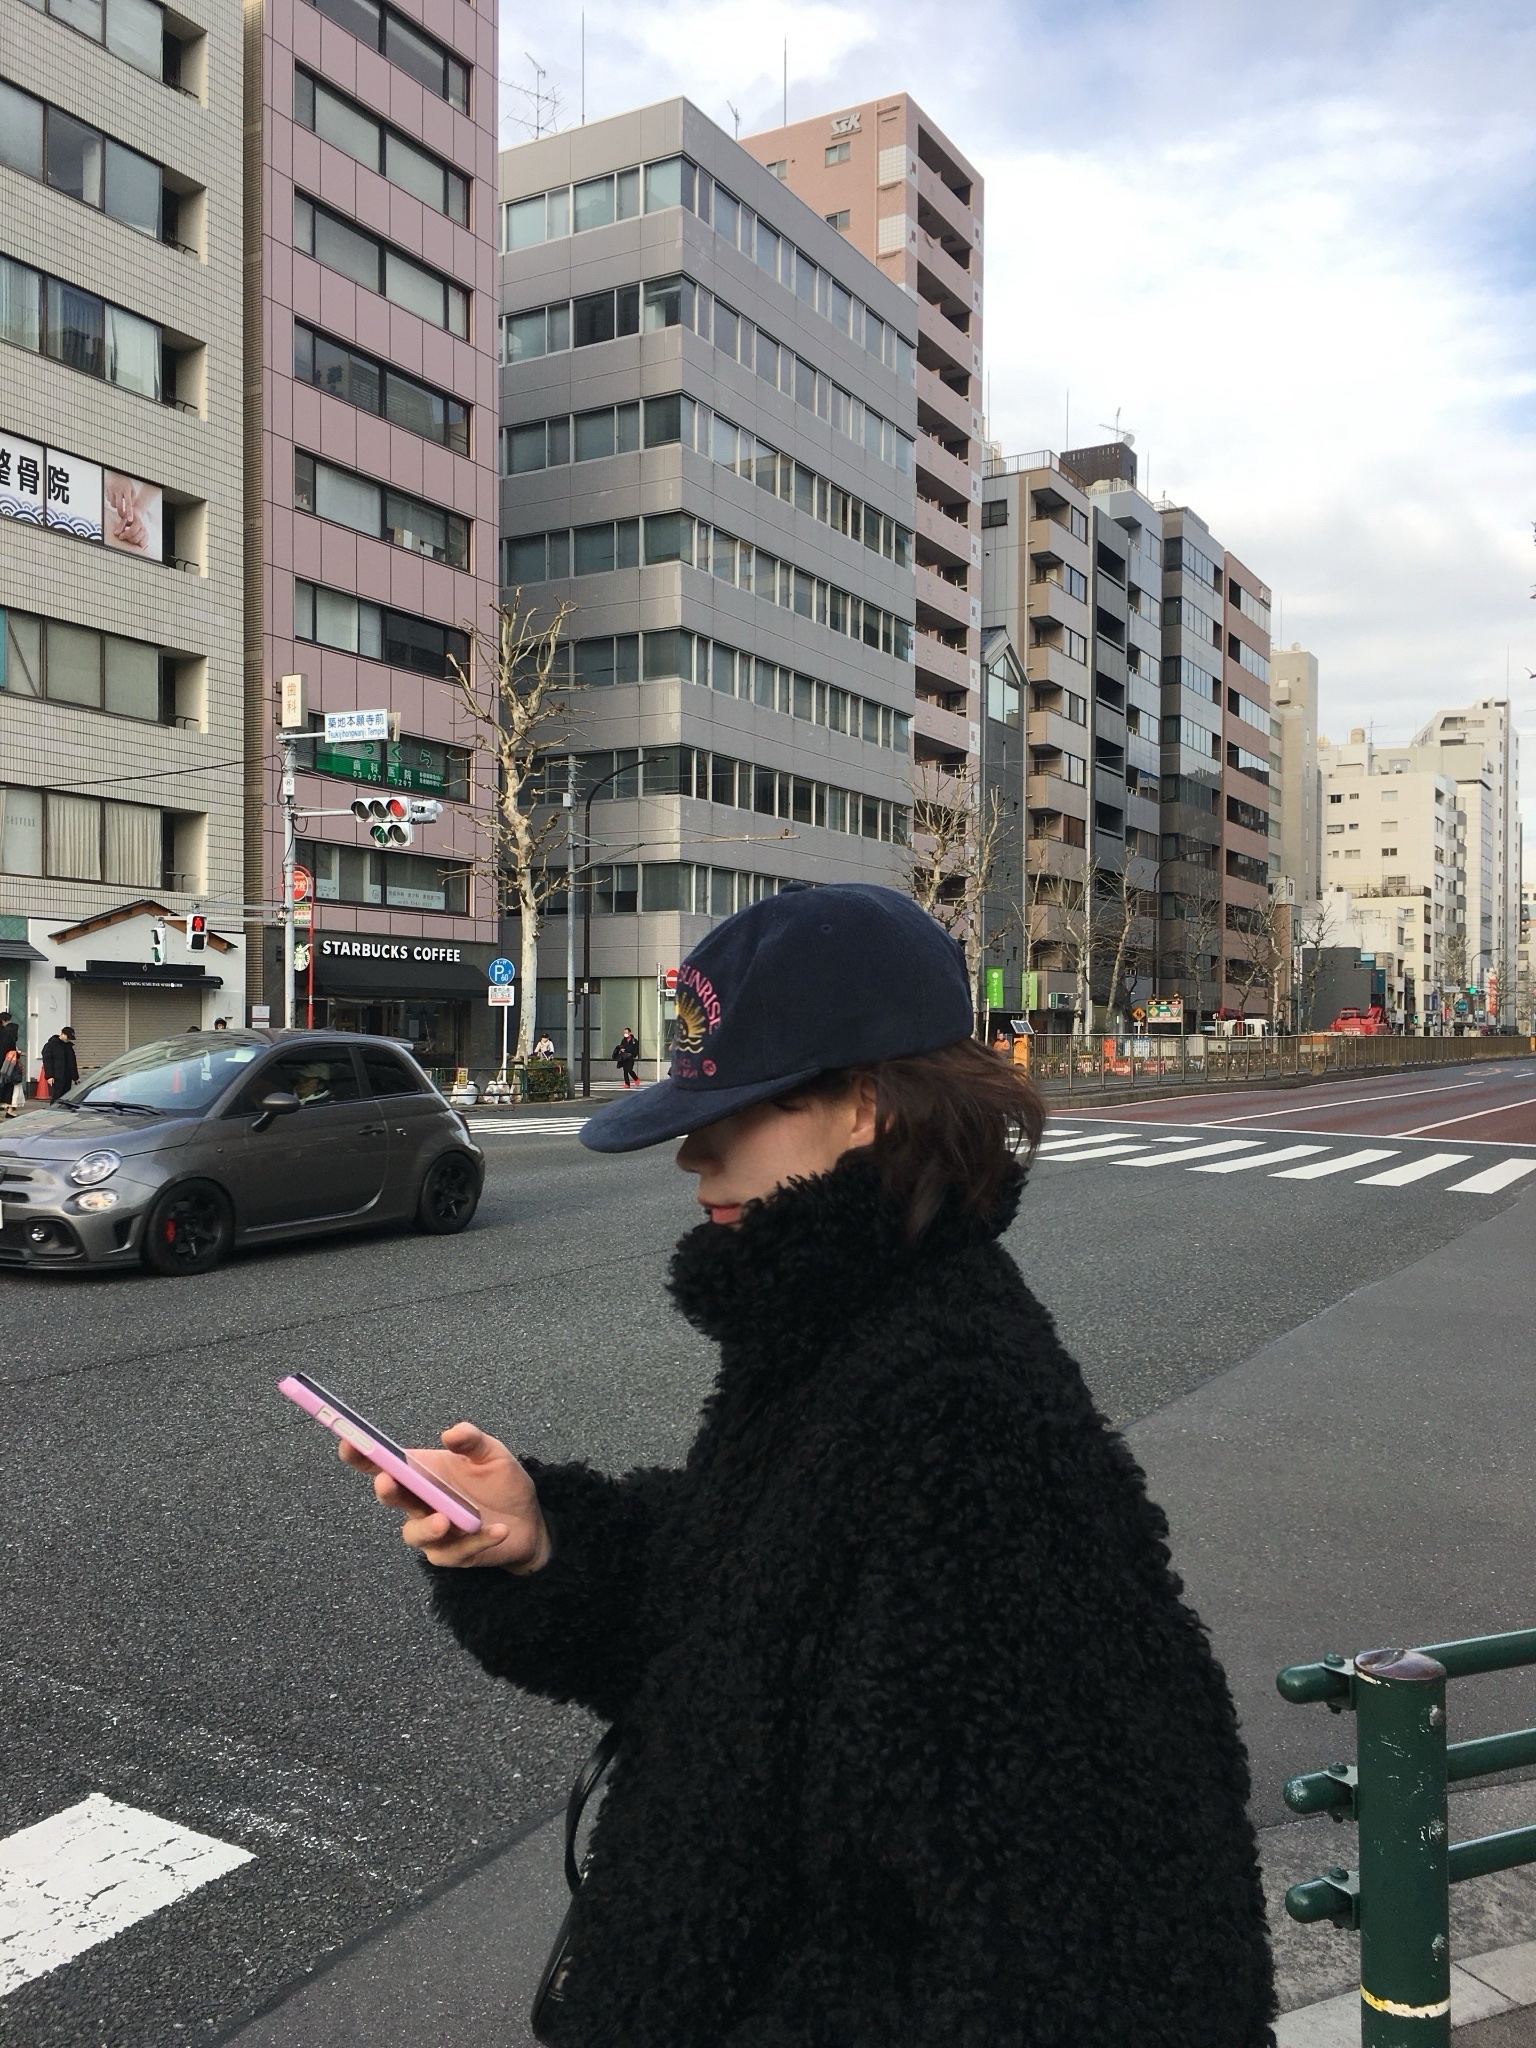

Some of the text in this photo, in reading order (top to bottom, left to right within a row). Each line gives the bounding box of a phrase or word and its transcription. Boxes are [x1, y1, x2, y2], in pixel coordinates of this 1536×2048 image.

[287, 682, 297, 714] 歯科
[327, 713, 384, 729] 築地本願寺前
[367, 727, 386, 736] Temple
[353, 760, 412, 780] 歯科医院
[322, 940, 461, 962] STARBUCKS COFFEE
[494, 964, 505, 982] P
